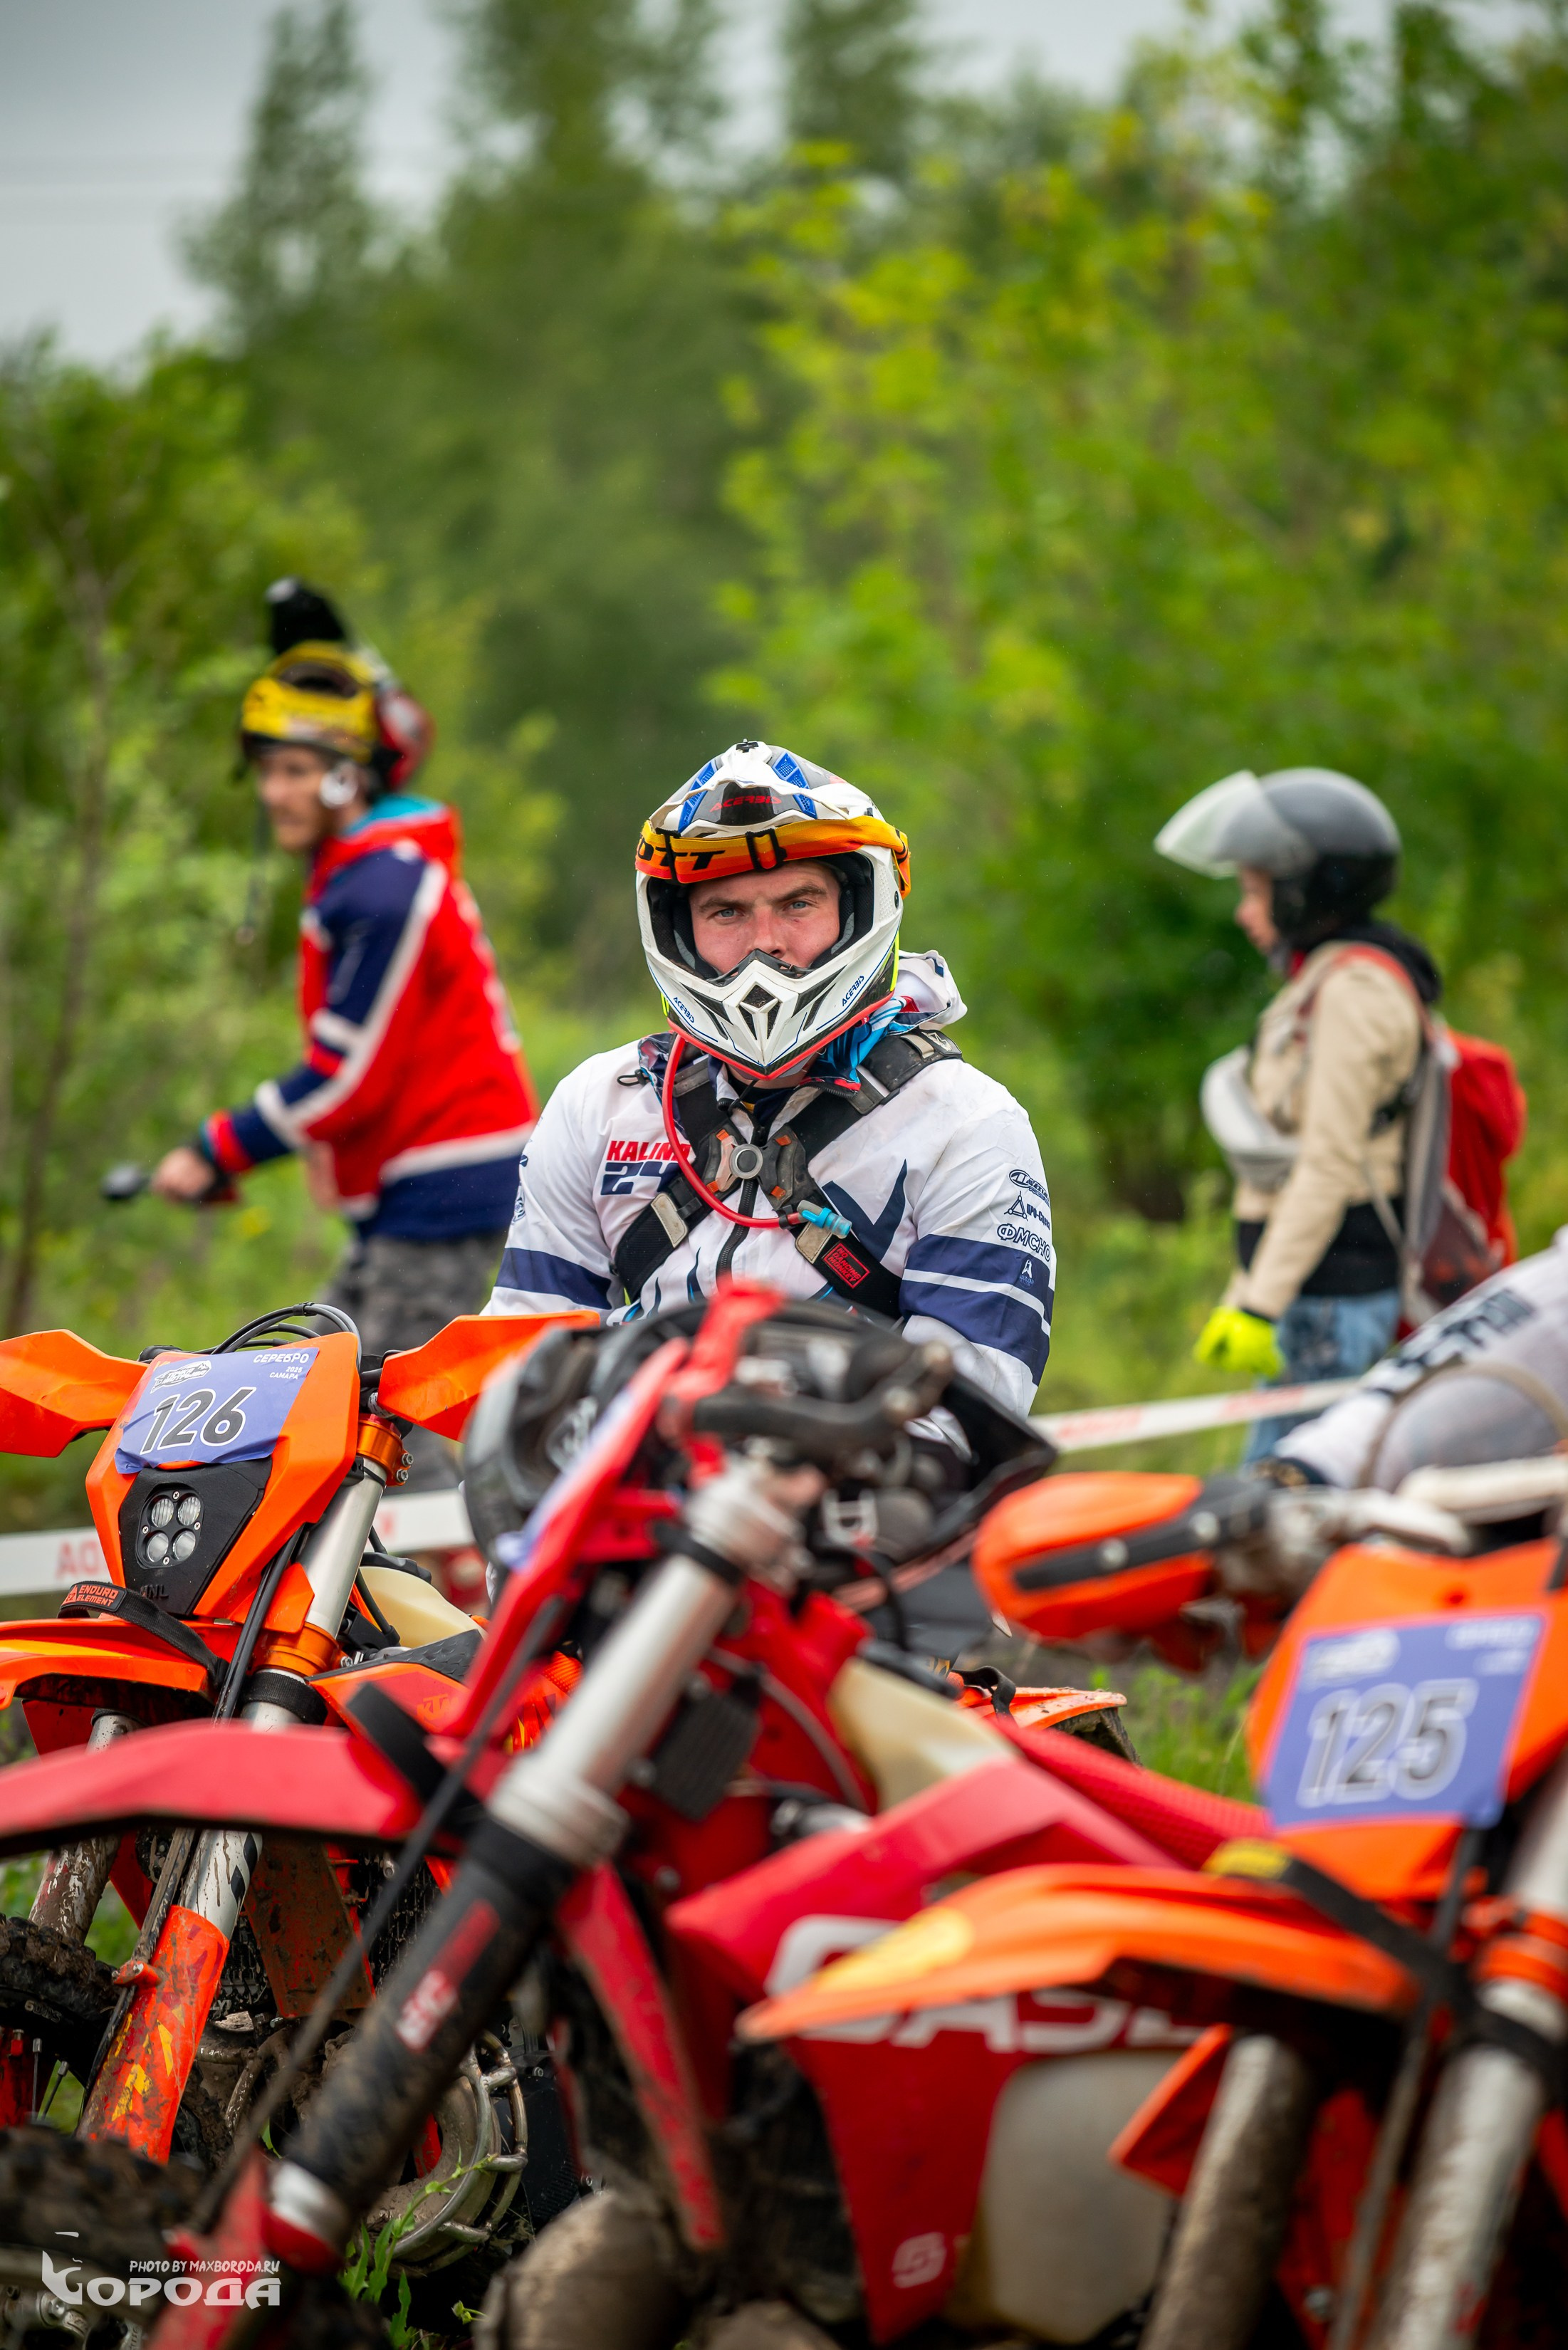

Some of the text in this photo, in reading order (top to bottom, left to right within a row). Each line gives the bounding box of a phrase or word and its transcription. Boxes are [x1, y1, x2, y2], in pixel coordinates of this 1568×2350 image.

[710, 795, 783, 813] ACERBIS
[841, 975, 865, 1007] ACERBIS
[673, 996, 695, 1023] ACERBIS
[832, 1252, 862, 1280] DANCING
[837, 1248, 848, 1258] NO
[827, 1256, 857, 1282] MONKEY
[253, 1353, 310, 1364] СЕРЕБРО
[140, 1386, 257, 1455] 126
[76, 1594, 114, 1607] ELEMENT
[78, 1584, 119, 1599] ENDURO
[1297, 1678, 1478, 1808] 125
